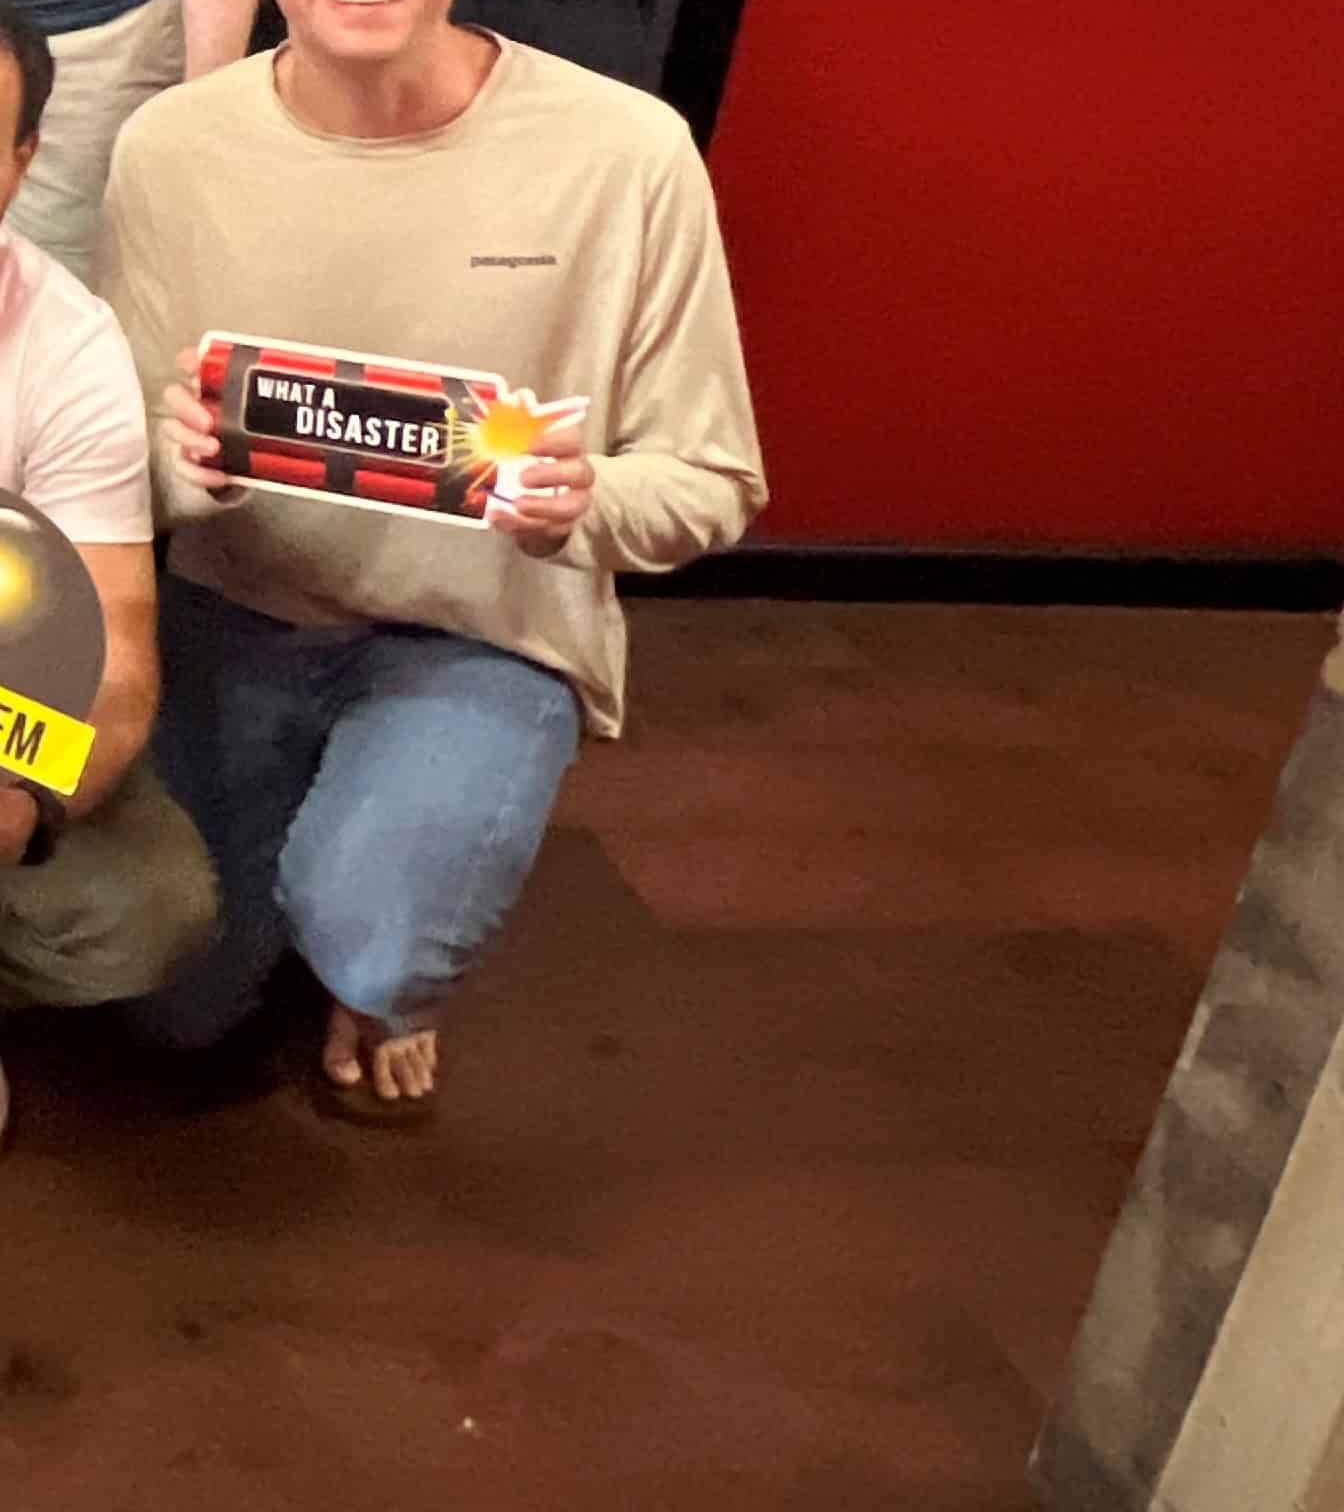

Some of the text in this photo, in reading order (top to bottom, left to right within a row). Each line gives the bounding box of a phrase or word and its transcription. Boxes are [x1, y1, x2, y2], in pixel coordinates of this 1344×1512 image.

[257, 376, 335, 408] WHAT A
[295, 403, 441, 456] DISASTER
